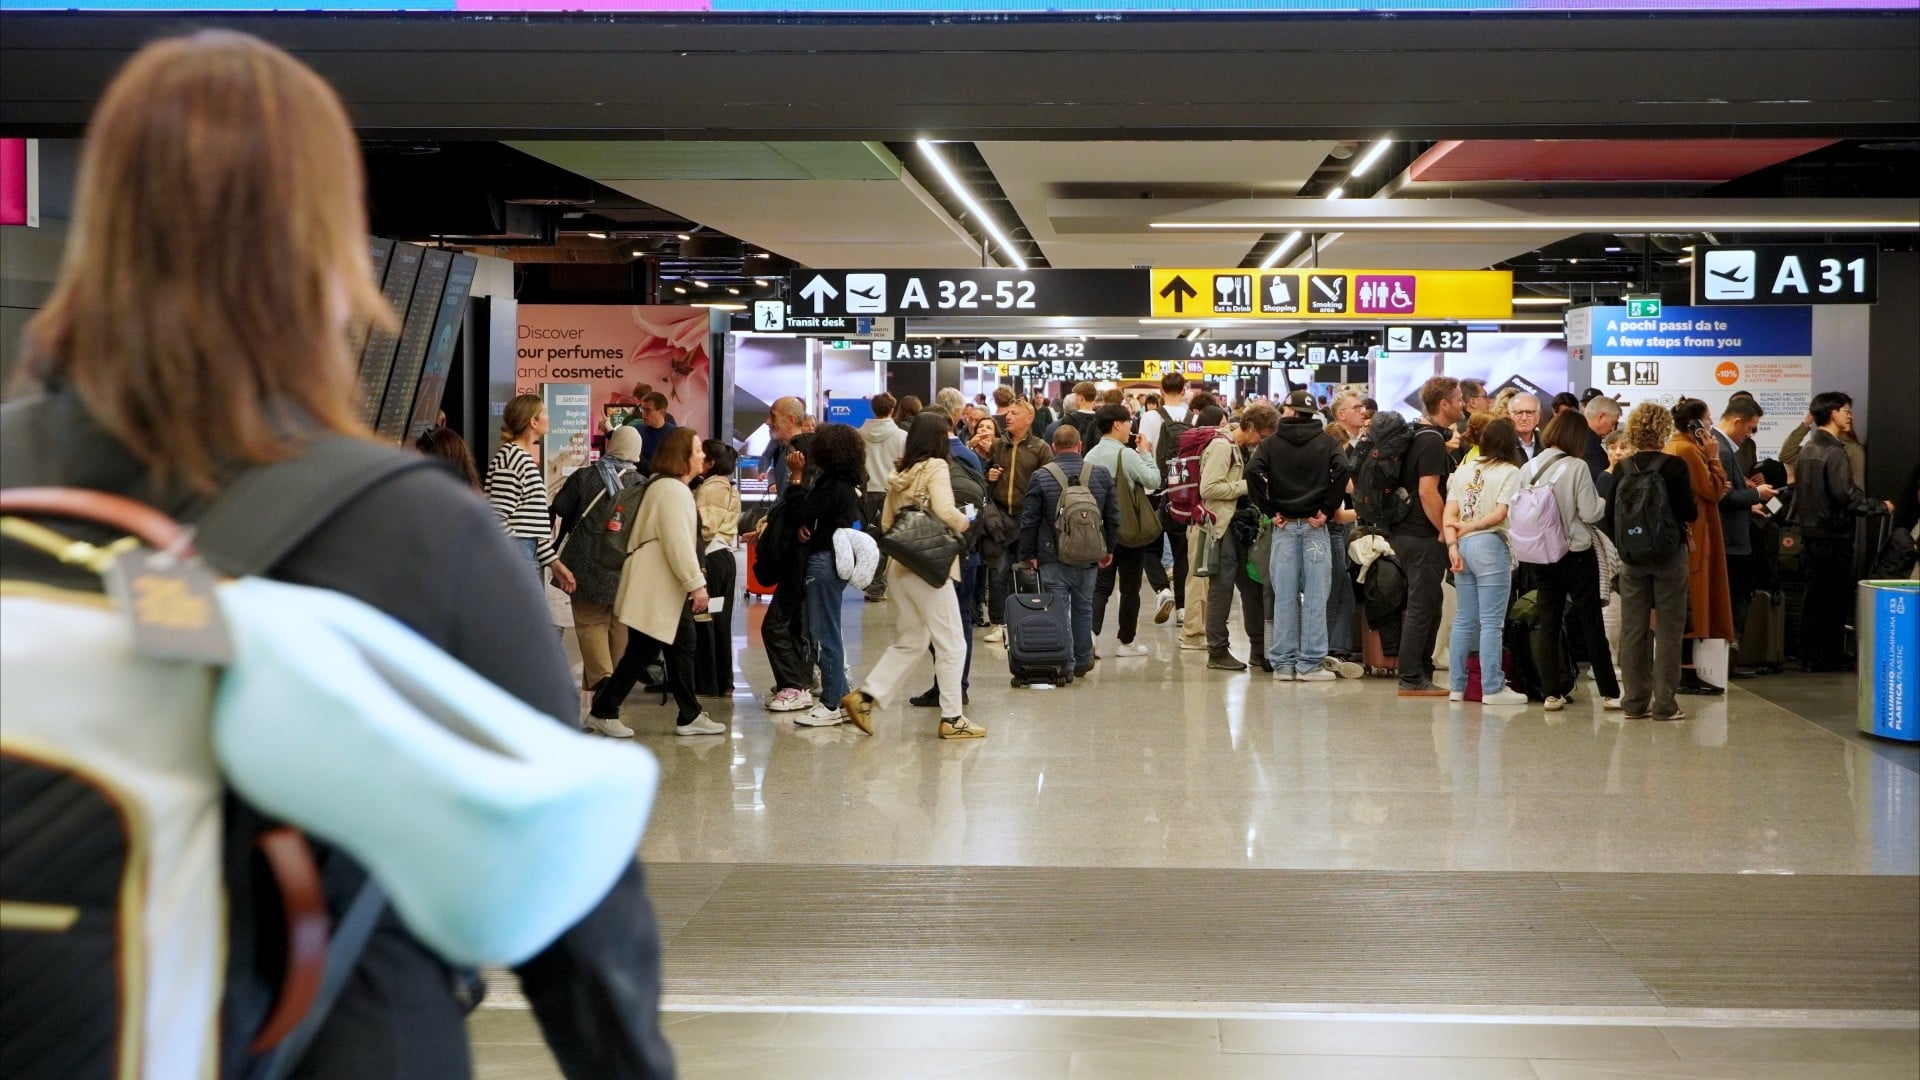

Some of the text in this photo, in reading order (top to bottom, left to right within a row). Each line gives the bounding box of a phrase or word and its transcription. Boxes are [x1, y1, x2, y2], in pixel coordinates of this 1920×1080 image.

[1772, 255, 1865, 294] A 31
[900, 277, 1036, 309] A 32-52
[1263, 304, 1296, 313] Shopping
[1312, 301, 1343, 310] Smoking
[786, 317, 845, 327] Transit desk
[1607, 319, 1727, 333] A pochi passi da te
[517, 324, 584, 340] Discover
[1418, 330, 1464, 349] A 32
[1607, 335, 1741, 350] A few steps from you
[517, 345, 624, 362] our perfumes
[896, 344, 932, 358] A 33
[1022, 343, 1084, 357] A 42-52
[1190, 343, 1251, 357] A 34-41
[1327, 349, 1370, 362] A 34-4
[517, 364, 624, 379] and cosmetic
[1022, 366, 1031, 375] A
[1066, 361, 1118, 373] A 44-52
[1241, 366, 1261, 375] A 44
[1716, 369, 1737, 379] -10%
